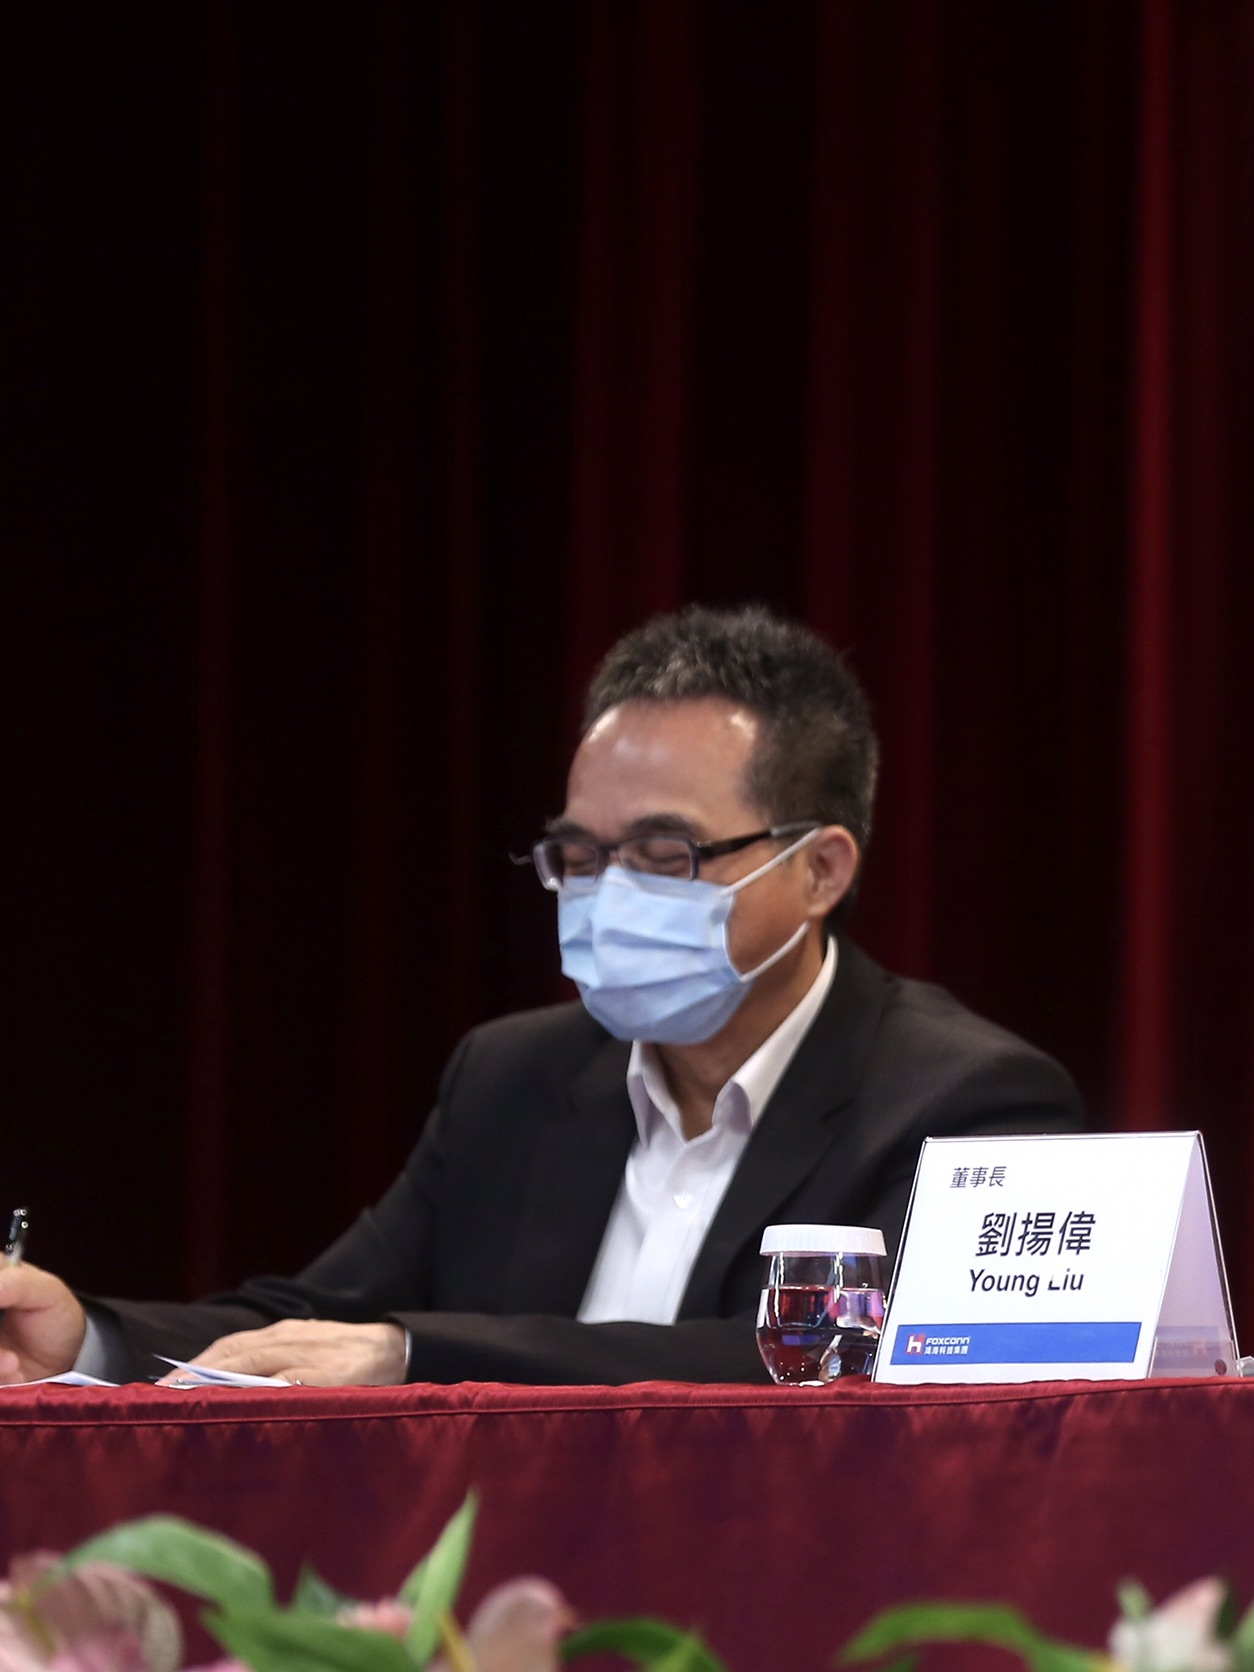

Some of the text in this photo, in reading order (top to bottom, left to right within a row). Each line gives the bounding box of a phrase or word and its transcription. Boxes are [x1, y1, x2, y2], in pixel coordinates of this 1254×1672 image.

[950, 1166, 1006, 1188] 董事長
[974, 1211, 1096, 1257] 劉揚偉
[969, 1269, 1040, 1298] Young
